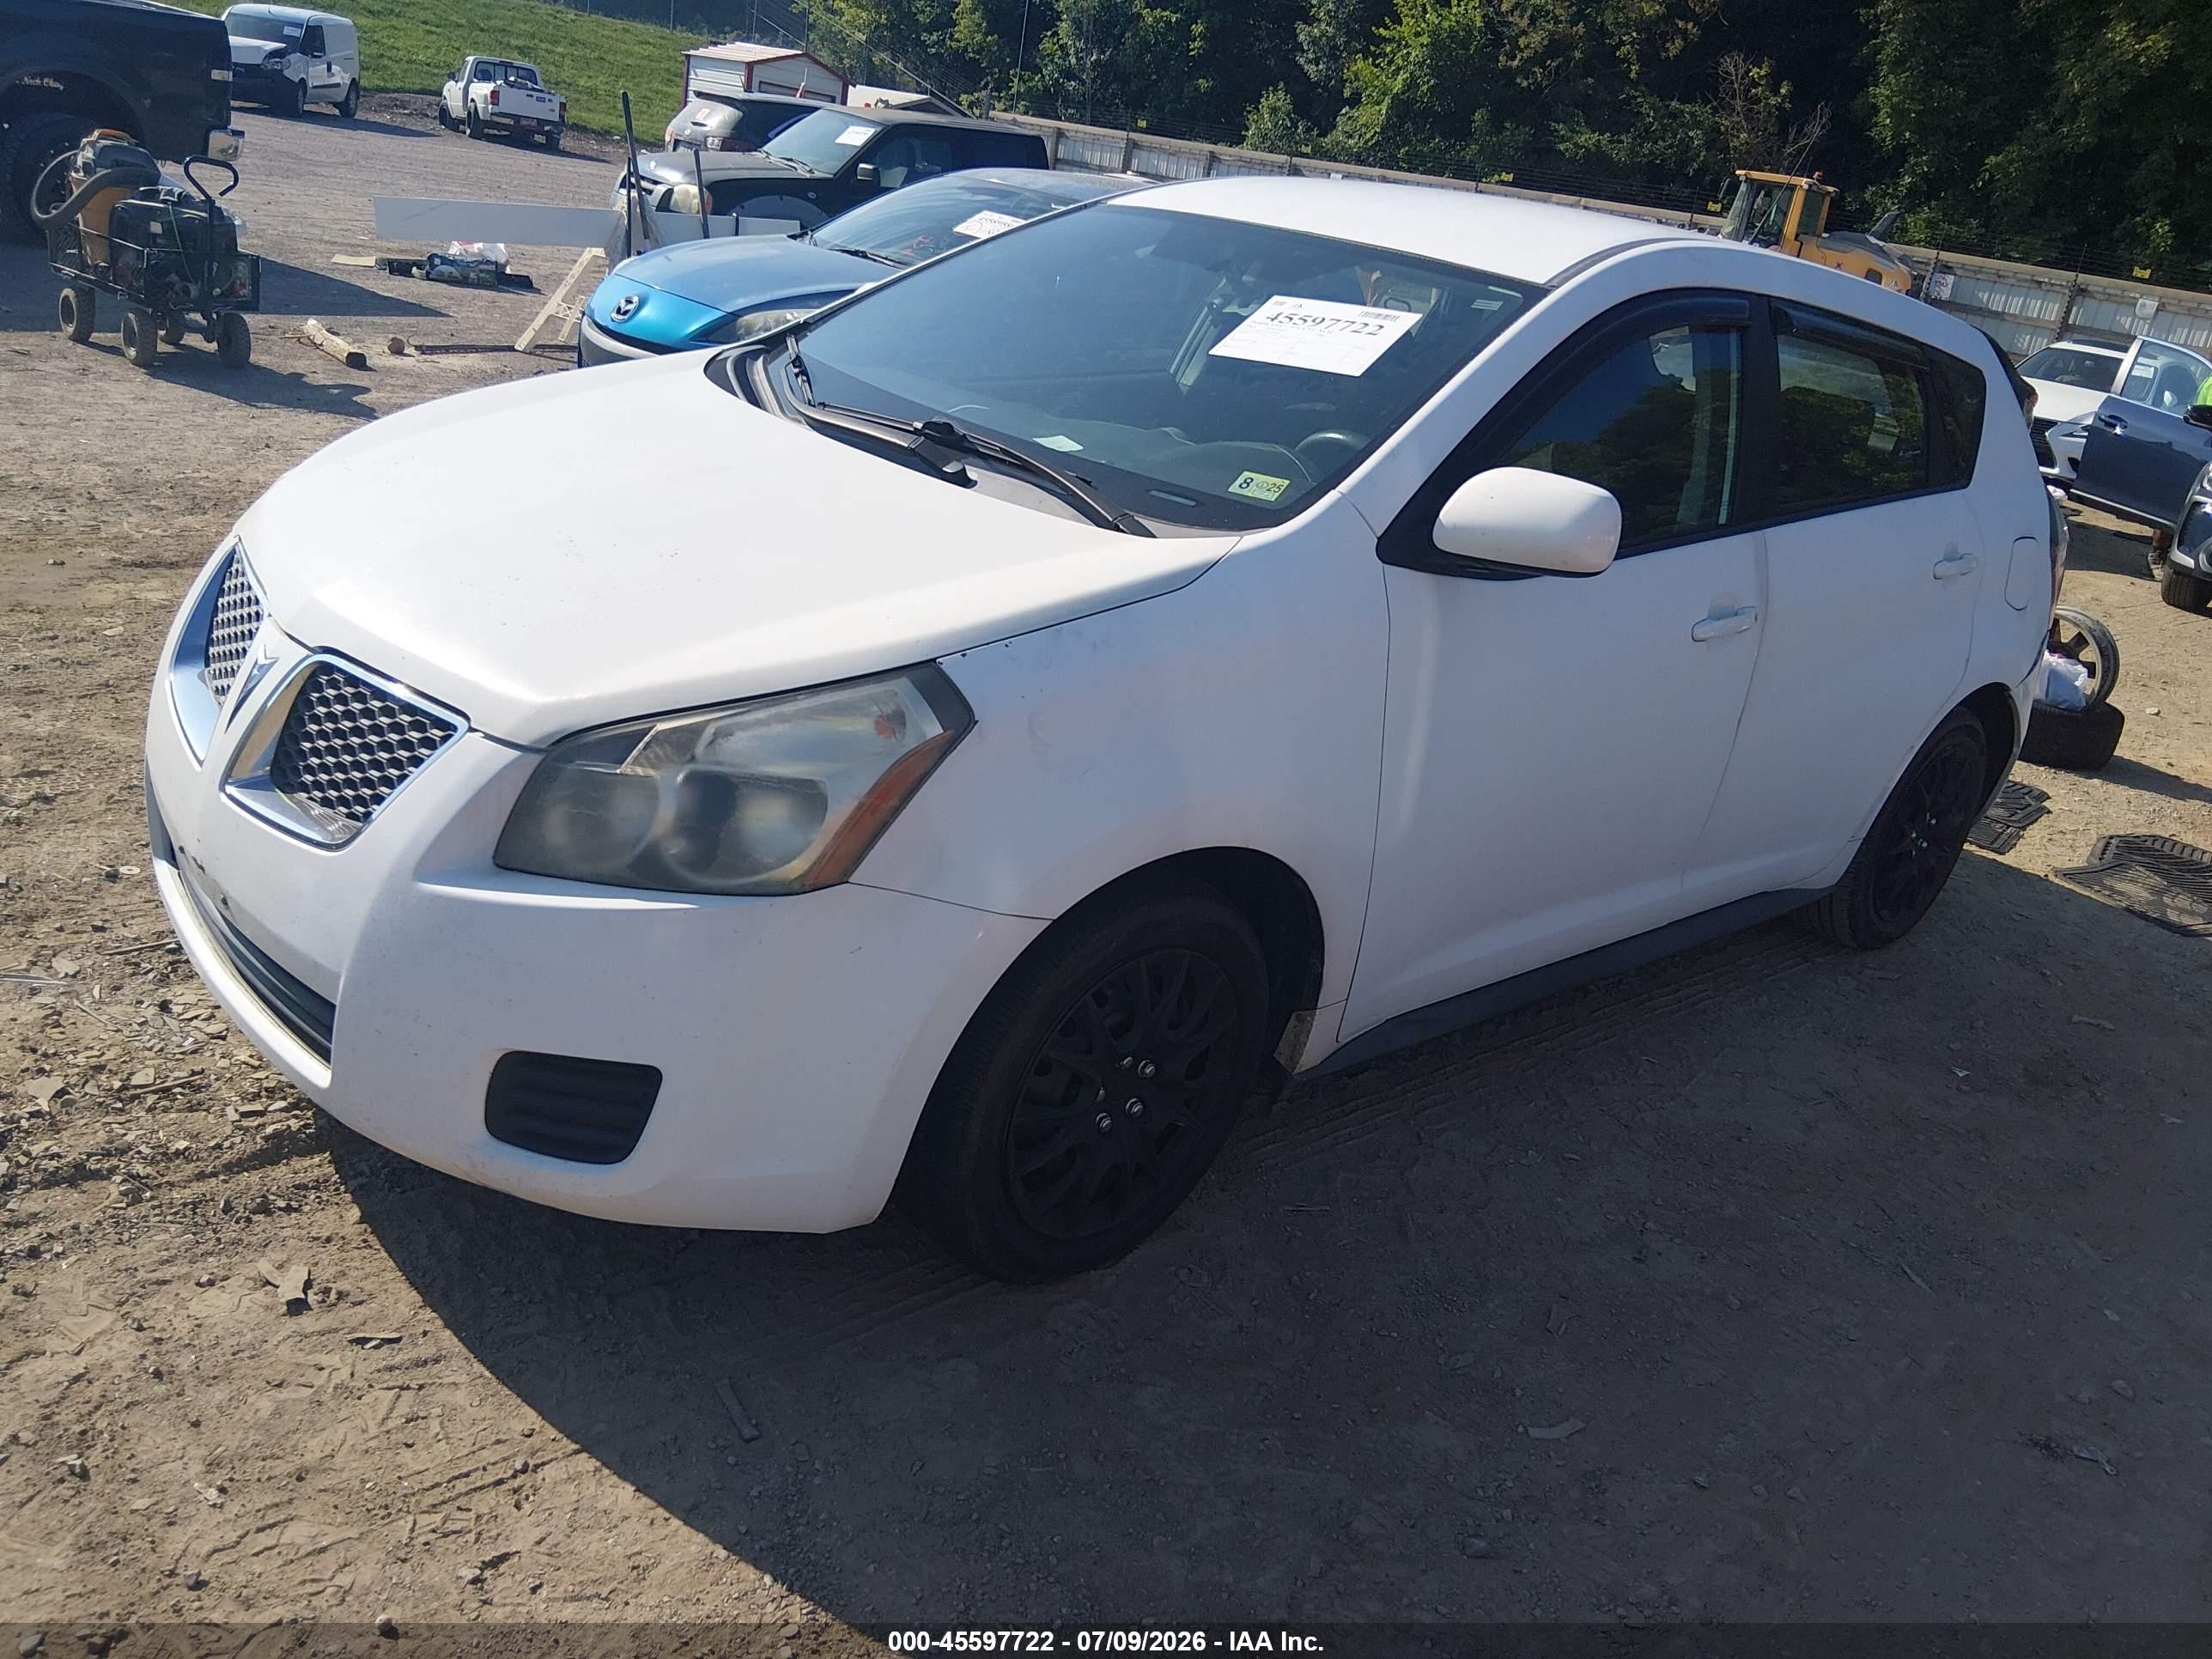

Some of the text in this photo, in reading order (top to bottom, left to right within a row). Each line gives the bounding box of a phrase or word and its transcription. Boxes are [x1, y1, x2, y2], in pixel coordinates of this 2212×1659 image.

[1266, 311, 1385, 336] 45597722
[1238, 477, 1284, 493] 8 25
